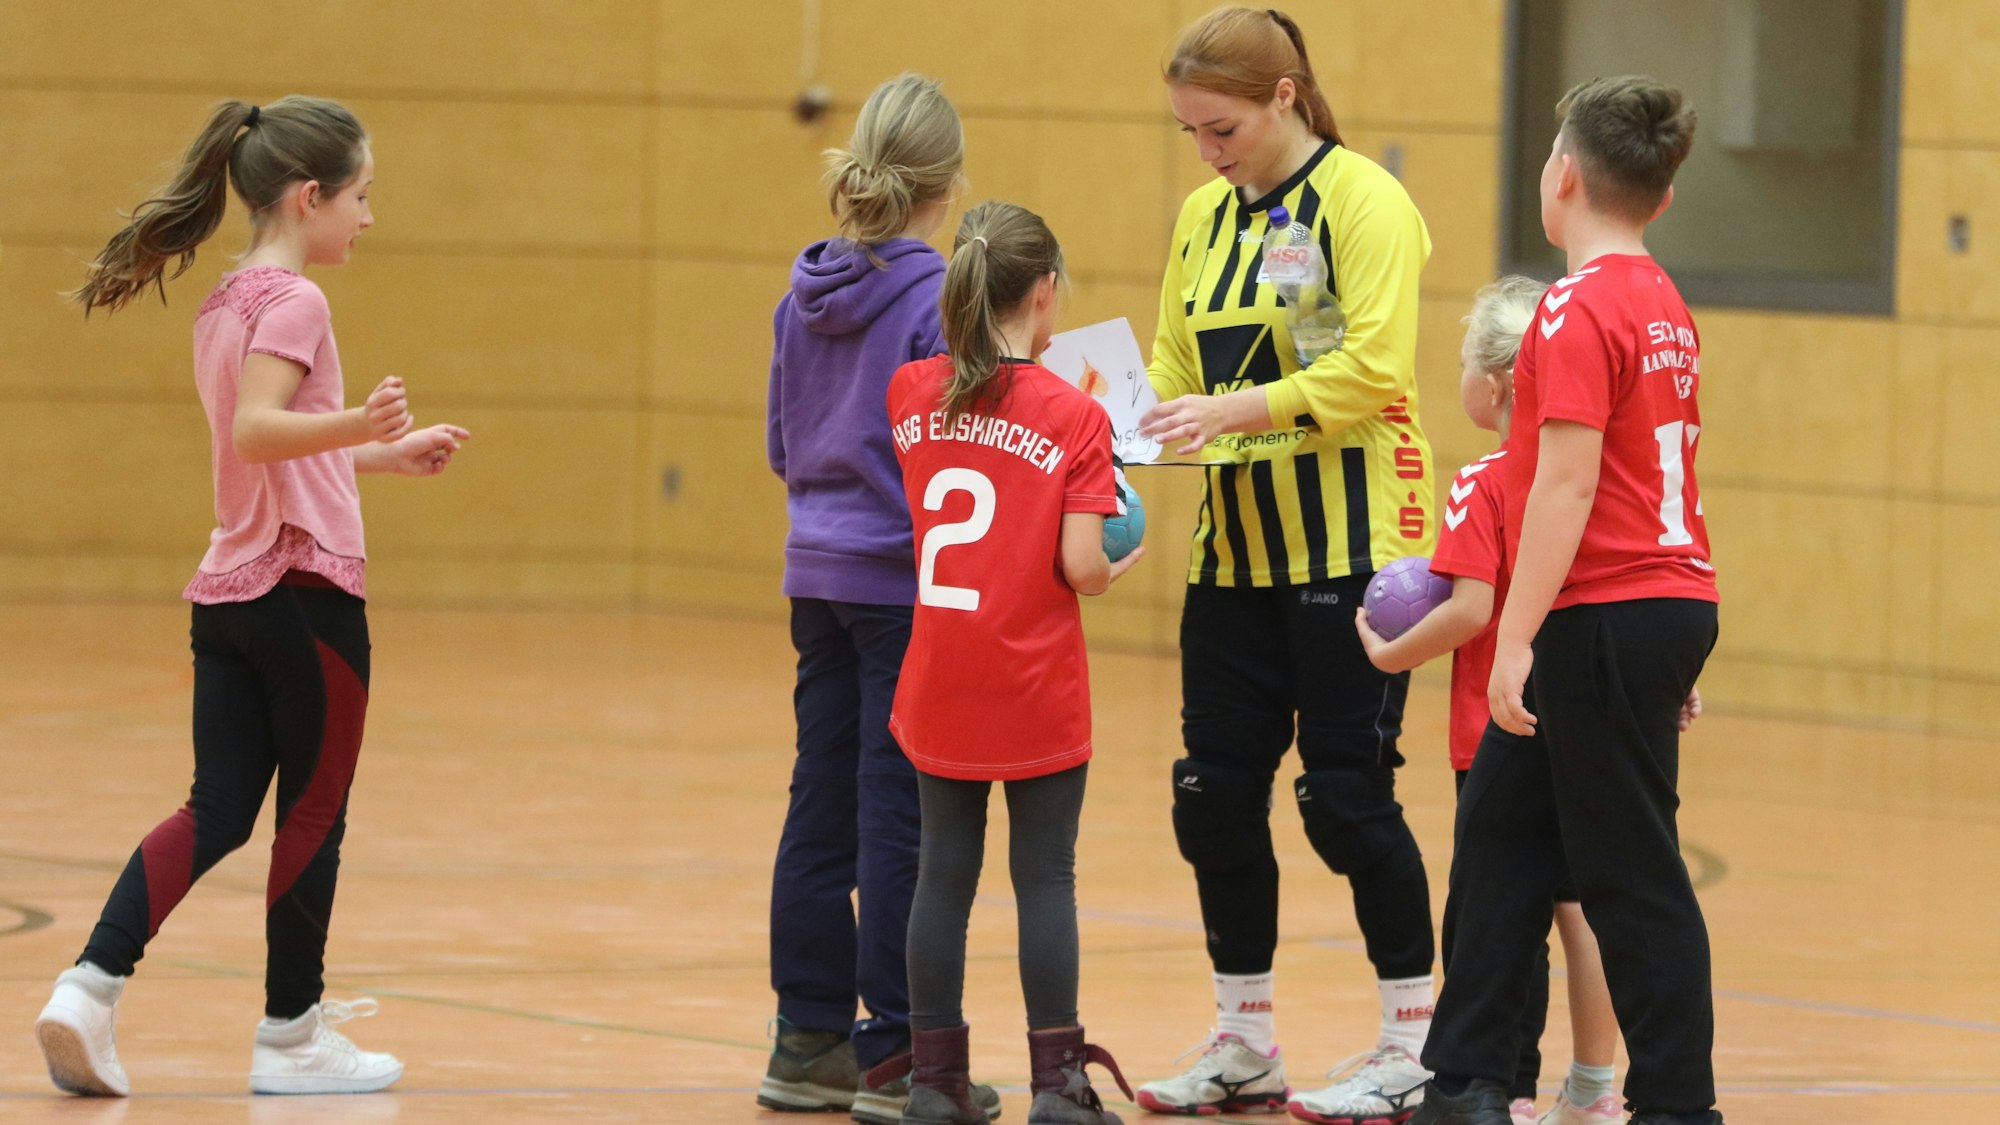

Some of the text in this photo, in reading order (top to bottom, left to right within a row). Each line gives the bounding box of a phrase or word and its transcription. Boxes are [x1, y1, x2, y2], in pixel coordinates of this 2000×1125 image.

[893, 414, 921, 454] HSG
[919, 467, 997, 612] 2
[1311, 592, 1339, 605] JAKO
